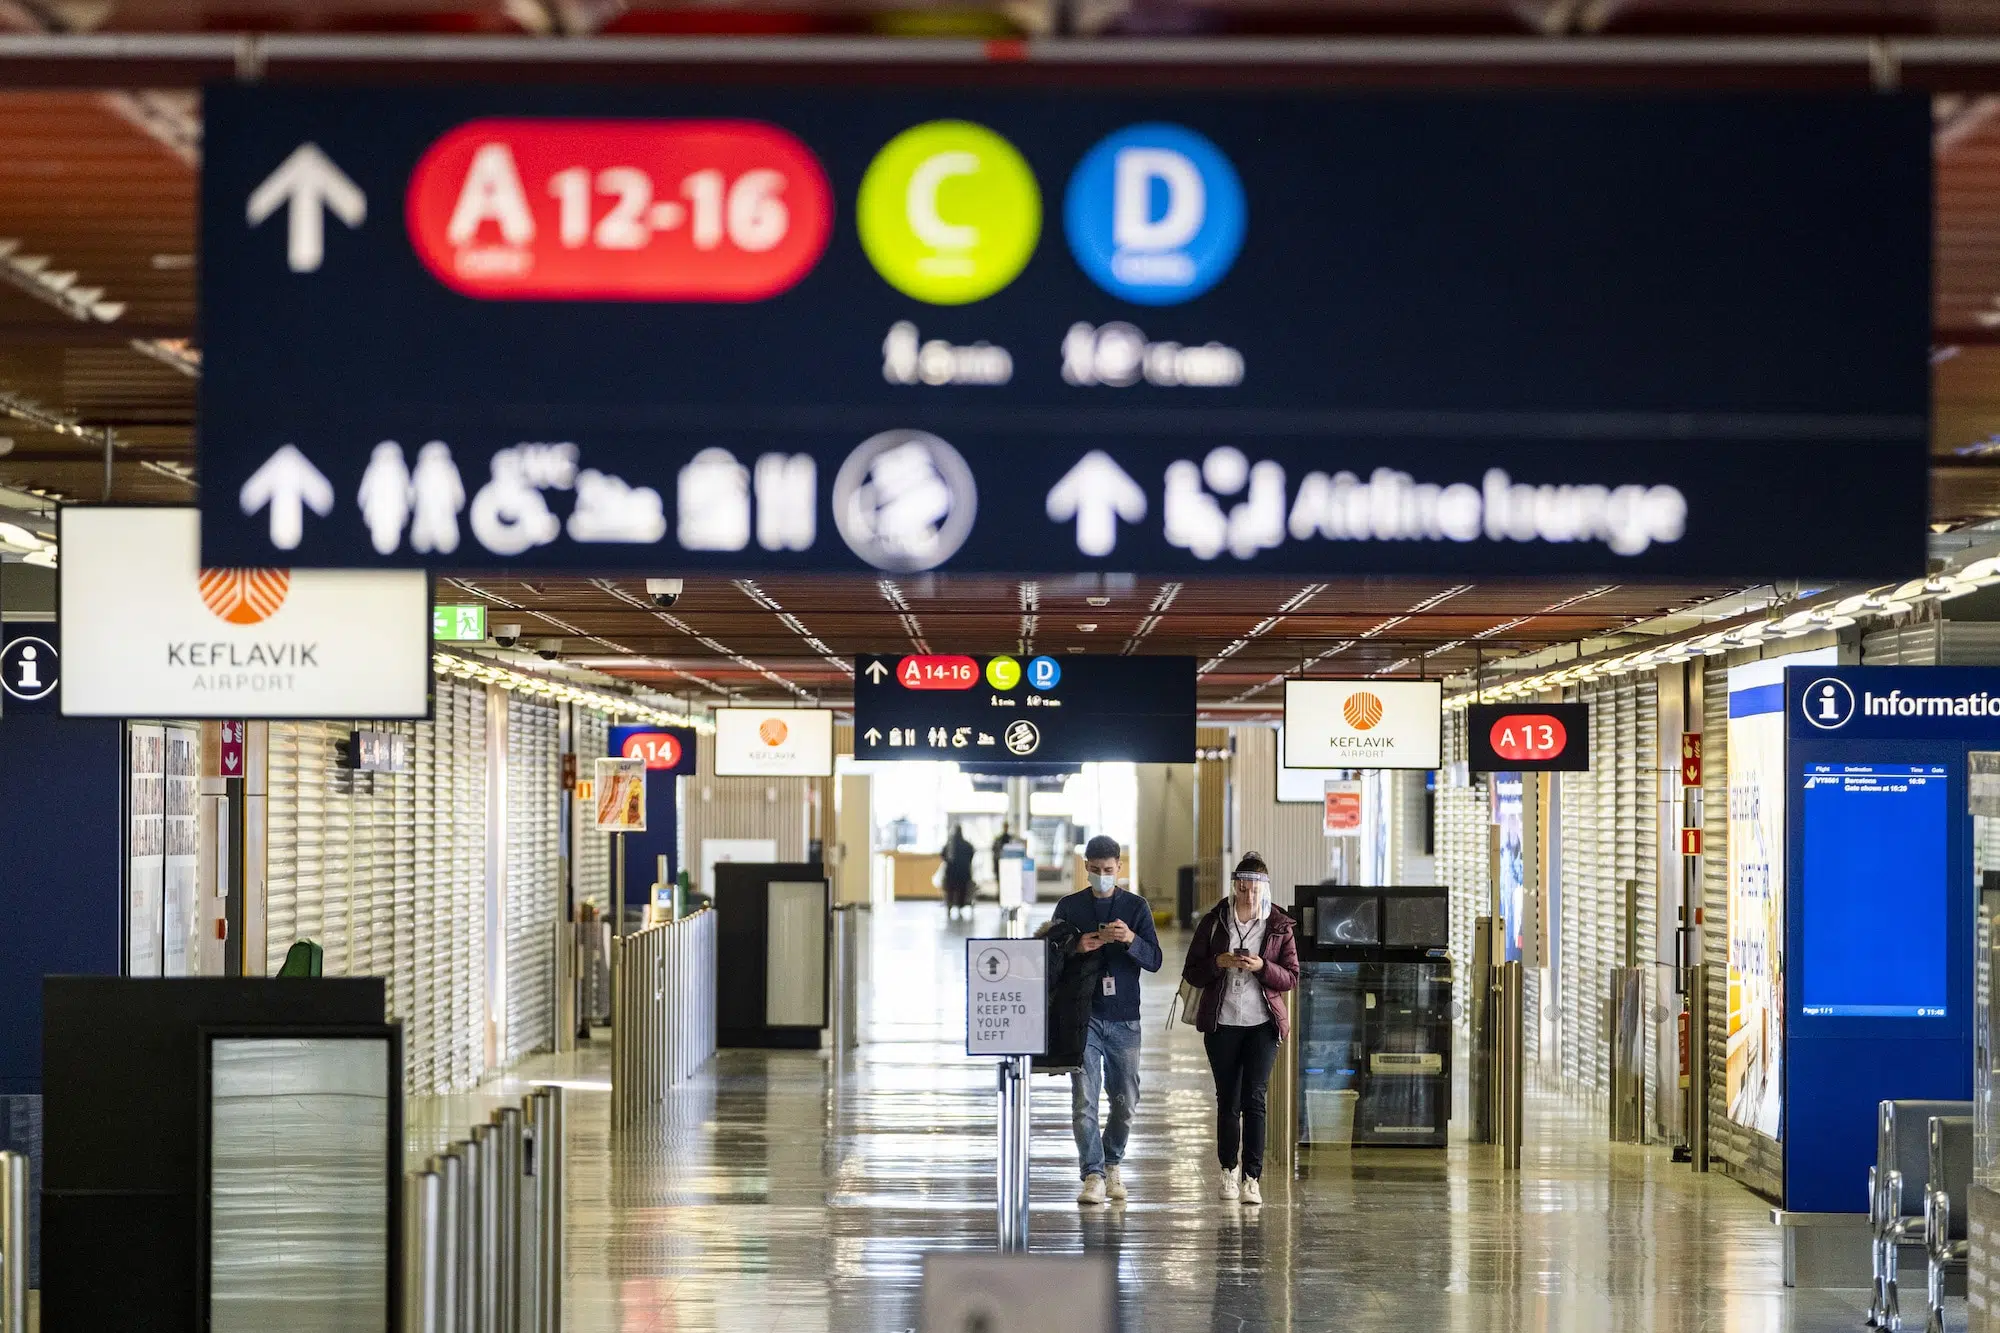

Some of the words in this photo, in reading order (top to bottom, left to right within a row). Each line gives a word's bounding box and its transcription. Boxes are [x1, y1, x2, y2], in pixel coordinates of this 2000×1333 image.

[446, 141, 536, 245] A
[547, 165, 790, 253] 12-16
[907, 151, 981, 250] C
[1113, 146, 1206, 249] D
[167, 641, 320, 668] KEFLAVIK
[905, 660, 921, 679] A
[925, 665, 972, 680] 14-16
[995, 661, 1011, 680] C
[1036, 660, 1054, 680] D
[192, 673, 295, 692] AIRPORT
[1330, 737, 1395, 748] KEFLAVIK
[1500, 728, 1517, 747] A
[1521, 725, 1555, 750] 13
[647, 741, 673, 761] 14
[1340, 750, 1385, 759] AIRPORT
[977, 991, 1022, 1002] PLEASE
[977, 1004, 1008, 1015] KEEP
[1011, 1004, 1026, 1015] TO
[977, 1017, 1010, 1028] YOUR
[976, 1030, 1005, 1041] LEFT
